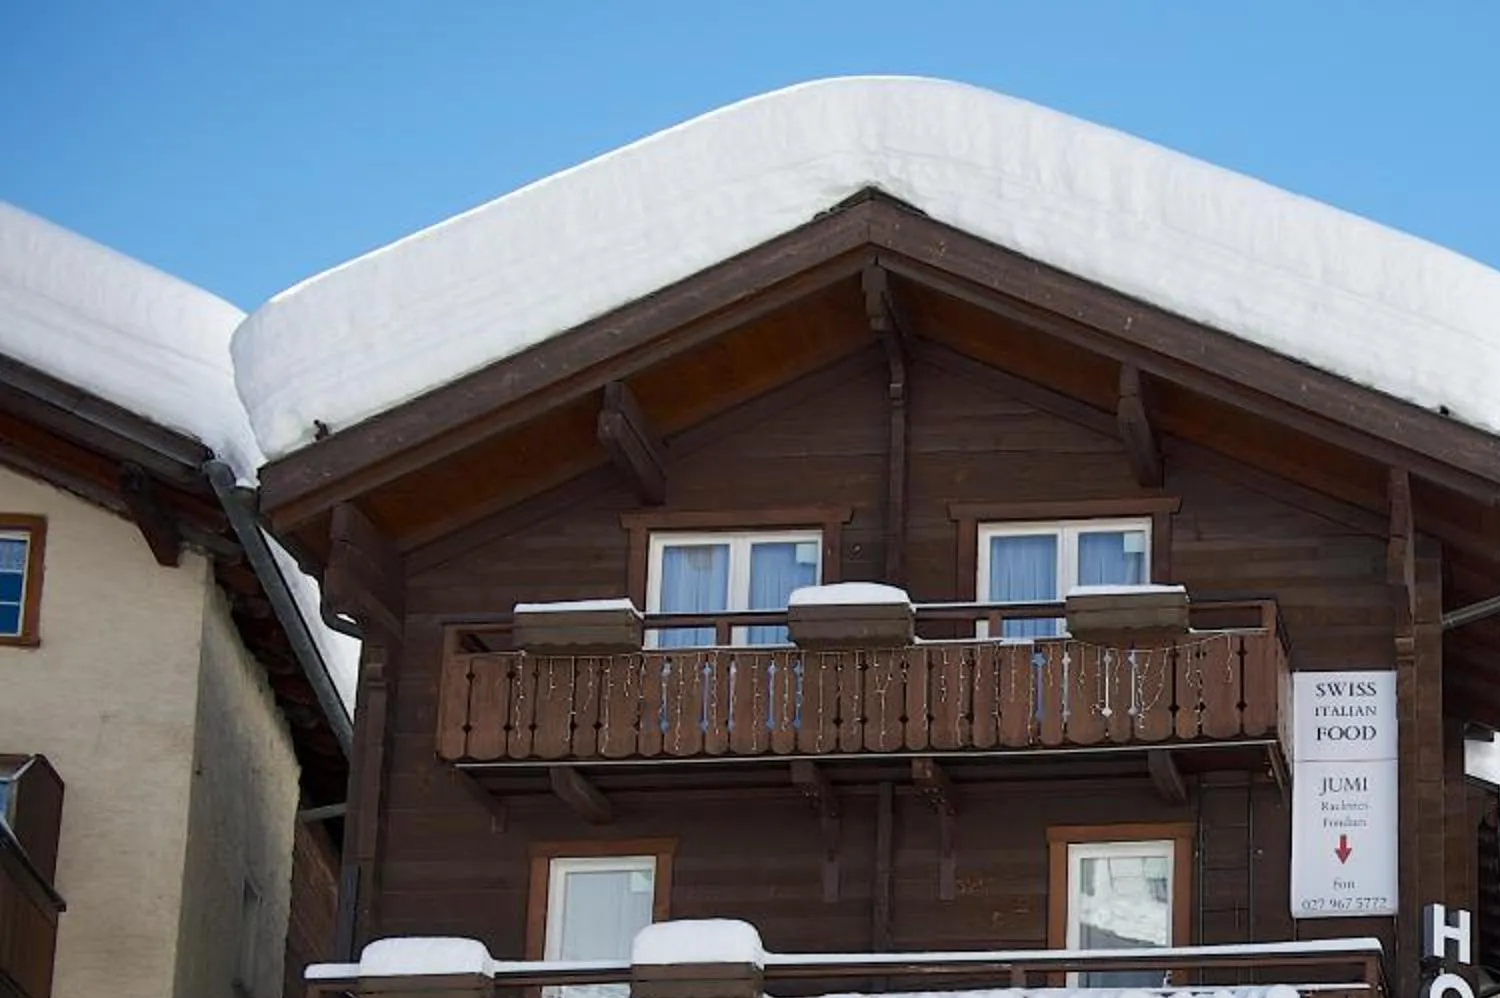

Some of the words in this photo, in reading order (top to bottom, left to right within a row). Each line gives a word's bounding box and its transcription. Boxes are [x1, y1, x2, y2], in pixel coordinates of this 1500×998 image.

[1315, 681, 1378, 698] SWISS
[1314, 705, 1378, 718] ITALIAN
[1316, 725, 1378, 742] FOOD
[1319, 776, 1369, 797] JUMI
[1301, 898, 1326, 911] 027
[1329, 897, 1352, 910] 967
